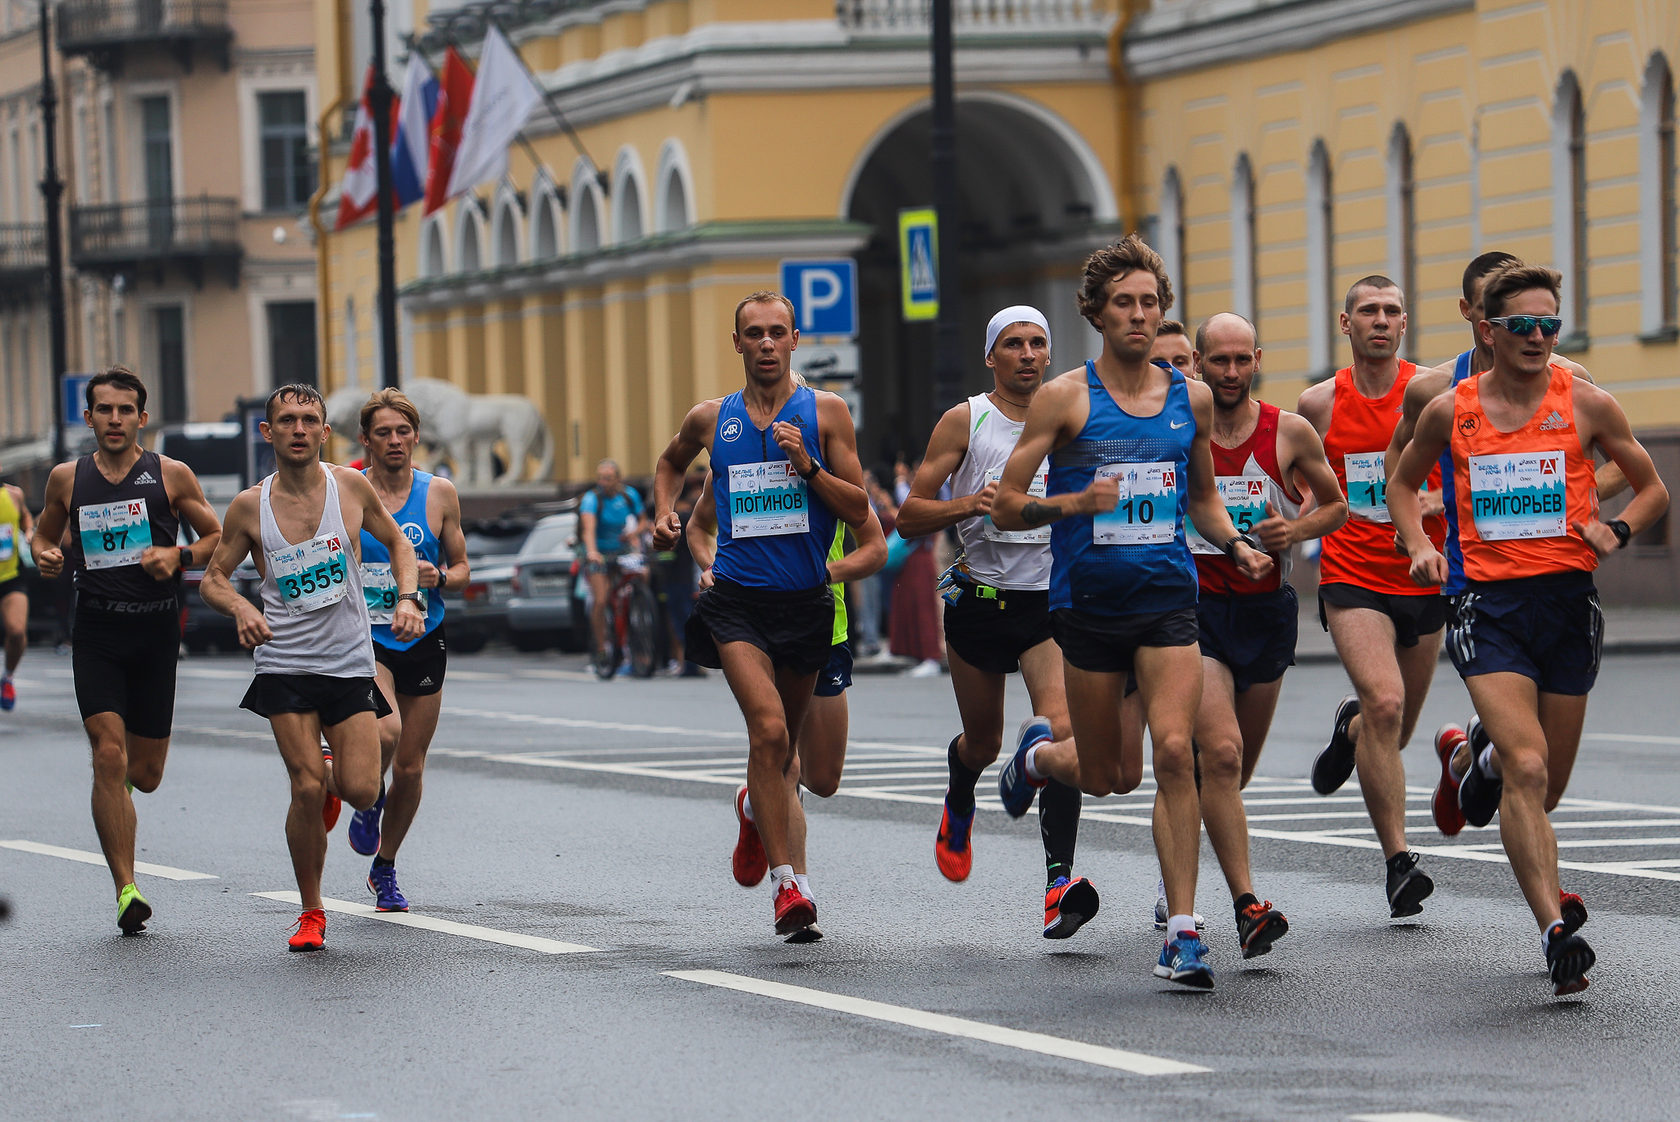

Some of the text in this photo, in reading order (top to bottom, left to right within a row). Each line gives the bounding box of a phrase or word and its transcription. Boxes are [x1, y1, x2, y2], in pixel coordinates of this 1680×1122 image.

[801, 268, 843, 330] P
[1540, 422, 1569, 431] adidas
[735, 493, 803, 514] ЛОГИНОВ
[1122, 499, 1154, 524] 10
[1475, 494, 1562, 517] ГРИГОРЬЕВ
[1228, 511, 1254, 535] 5
[103, 530, 128, 551] 87
[285, 563, 344, 599] 3555
[106, 598, 174, 613] TECHFIT
